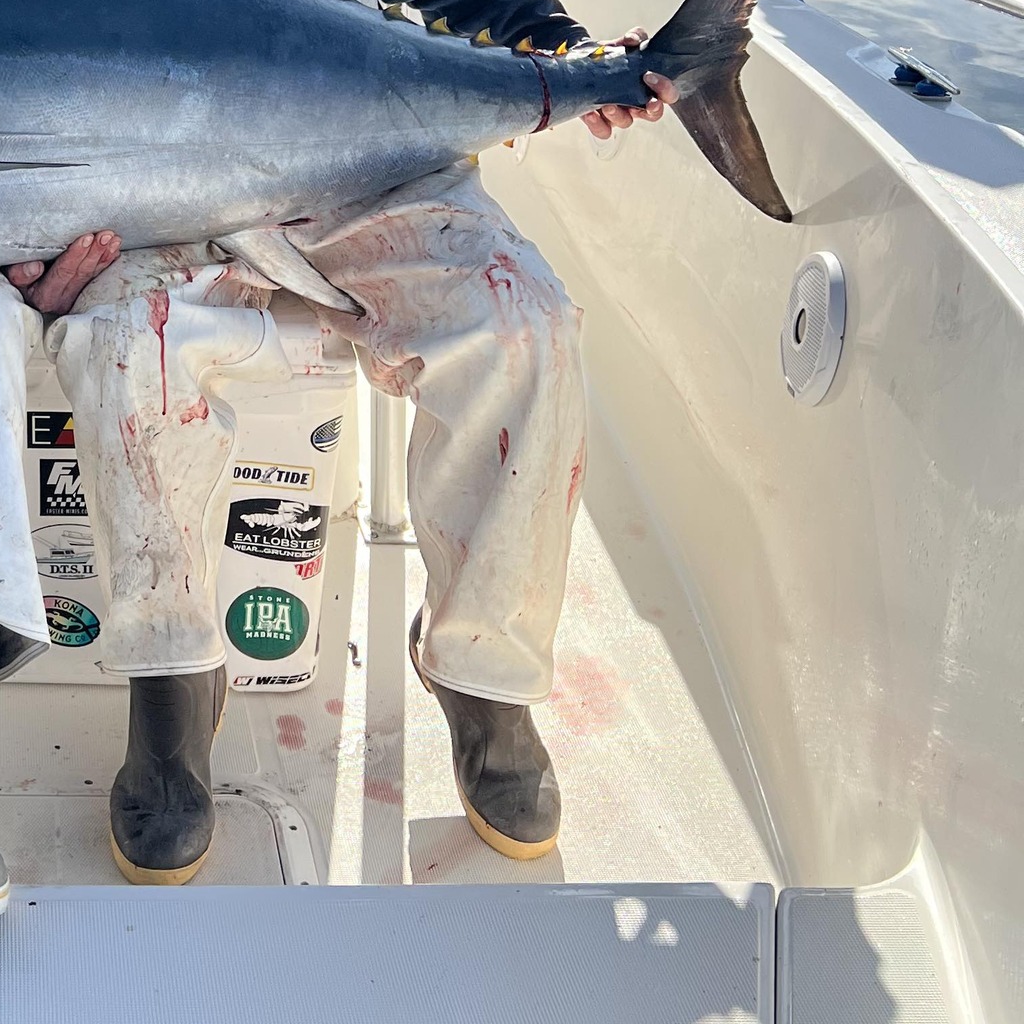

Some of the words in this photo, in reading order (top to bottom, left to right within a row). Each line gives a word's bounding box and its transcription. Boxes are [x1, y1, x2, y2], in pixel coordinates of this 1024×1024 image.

[233, 466, 262, 479] OOD
[276, 470, 310, 485] TIDE
[234, 532, 261, 543] EAT
[262, 535, 322, 549] LOBSTER
[53, 598, 85, 617] KONA
[249, 594, 291, 603] STONE
[243, 602, 293, 634] IPA
[246, 632, 291, 641] MADNESS
